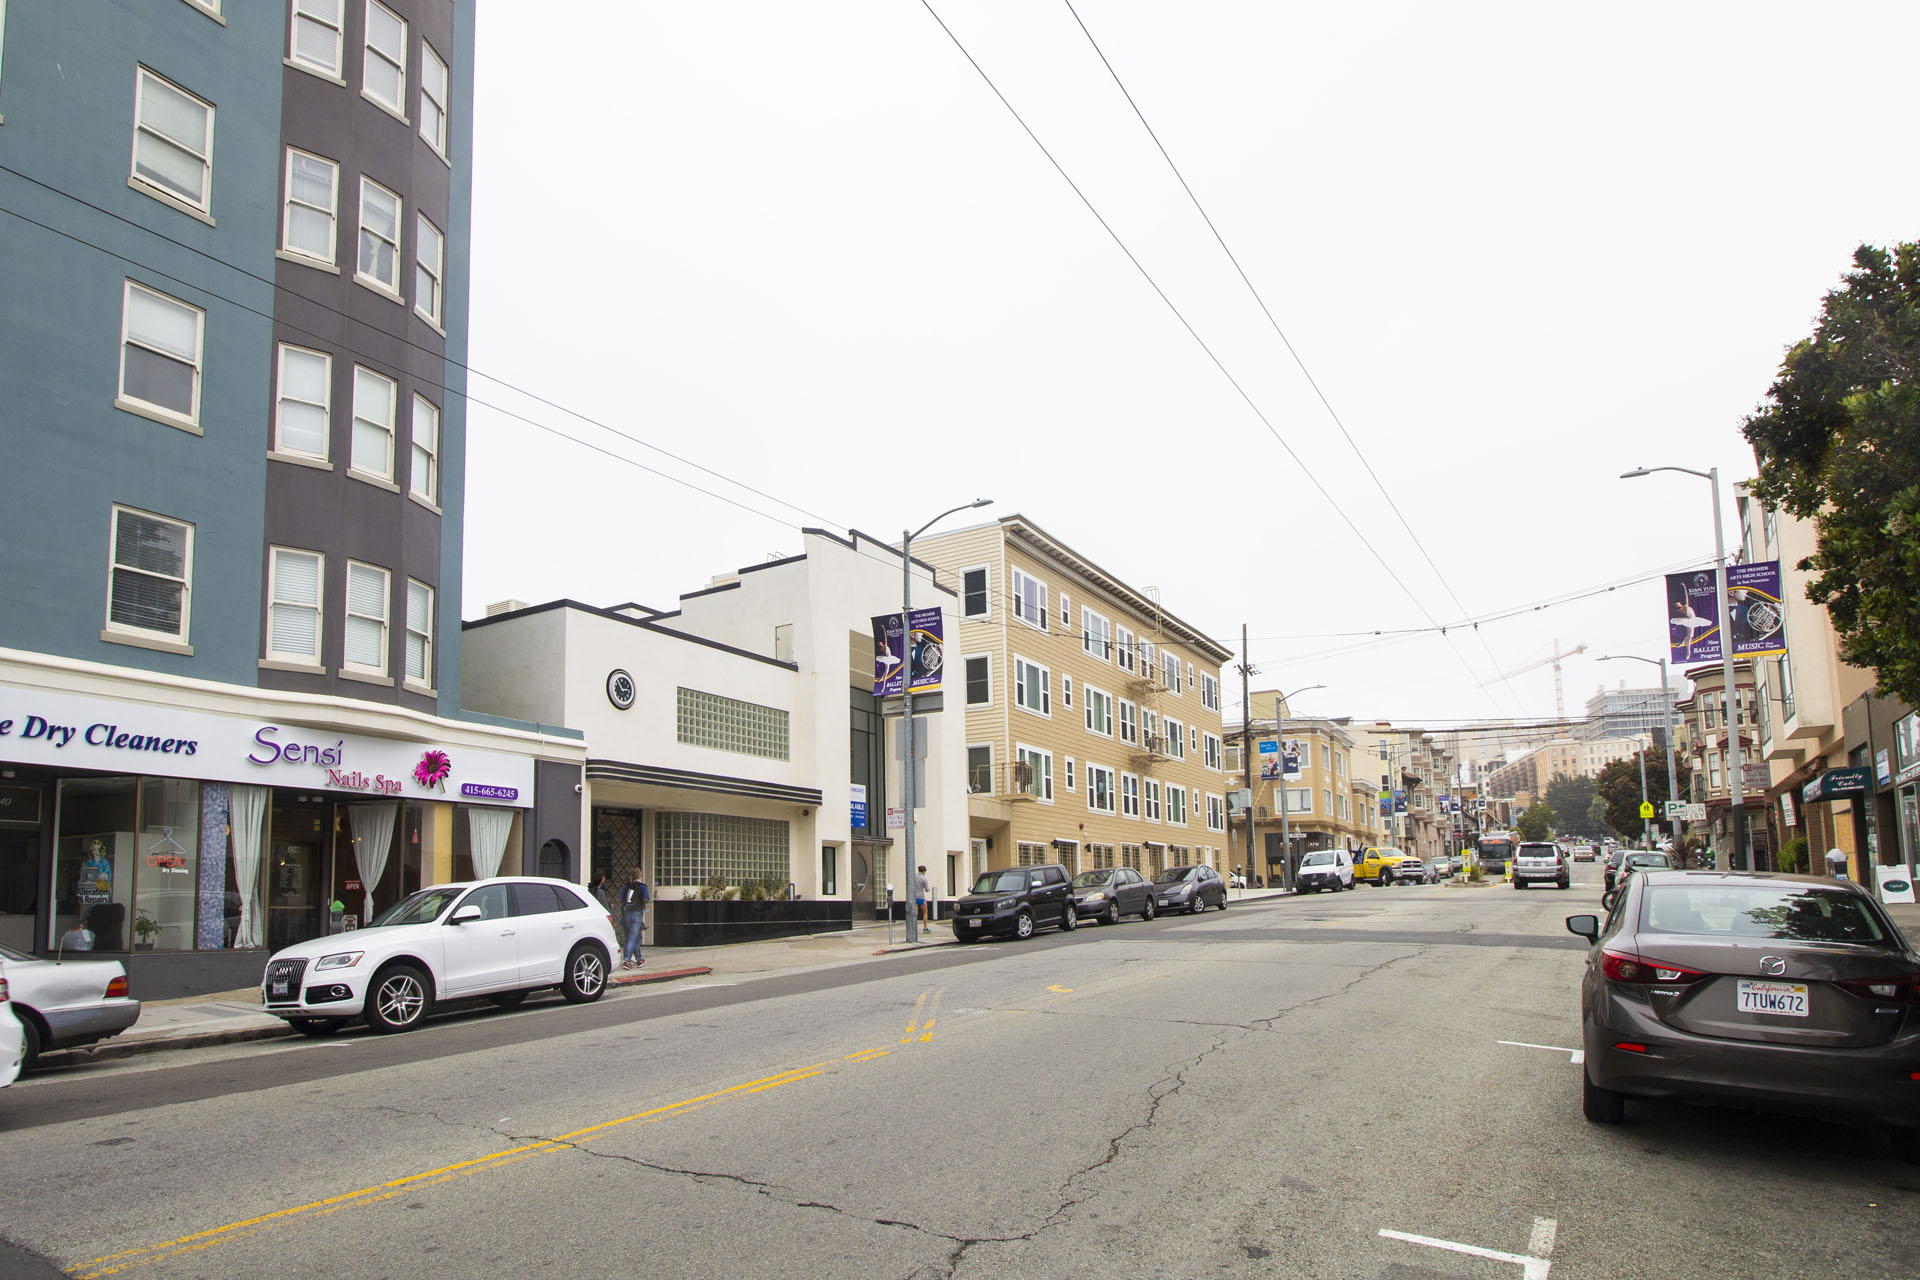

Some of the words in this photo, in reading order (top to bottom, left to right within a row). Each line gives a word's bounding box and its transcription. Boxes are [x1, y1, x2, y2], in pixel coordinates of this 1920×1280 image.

[1693, 645, 1720, 653] BALLET
[1737, 643, 1764, 651] MUSIC
[0, 719, 14, 736] e
[20, 714, 76, 748] Dry
[85, 723, 198, 756] Cleaners
[327, 768, 370, 789] Nails
[374, 774, 403, 795] Spa
[1829, 773, 1865, 781] Friendly
[464, 784, 515, 799] 415-665-6245
[1668, 803, 1678, 814] P
[146, 856, 184, 867] OPEN
[78, 888, 111, 896] Alterations
[85, 895, 109, 904] Repairs
[1752, 983, 1793, 993] California
[1742, 992, 1804, 1011] 7TUW672
